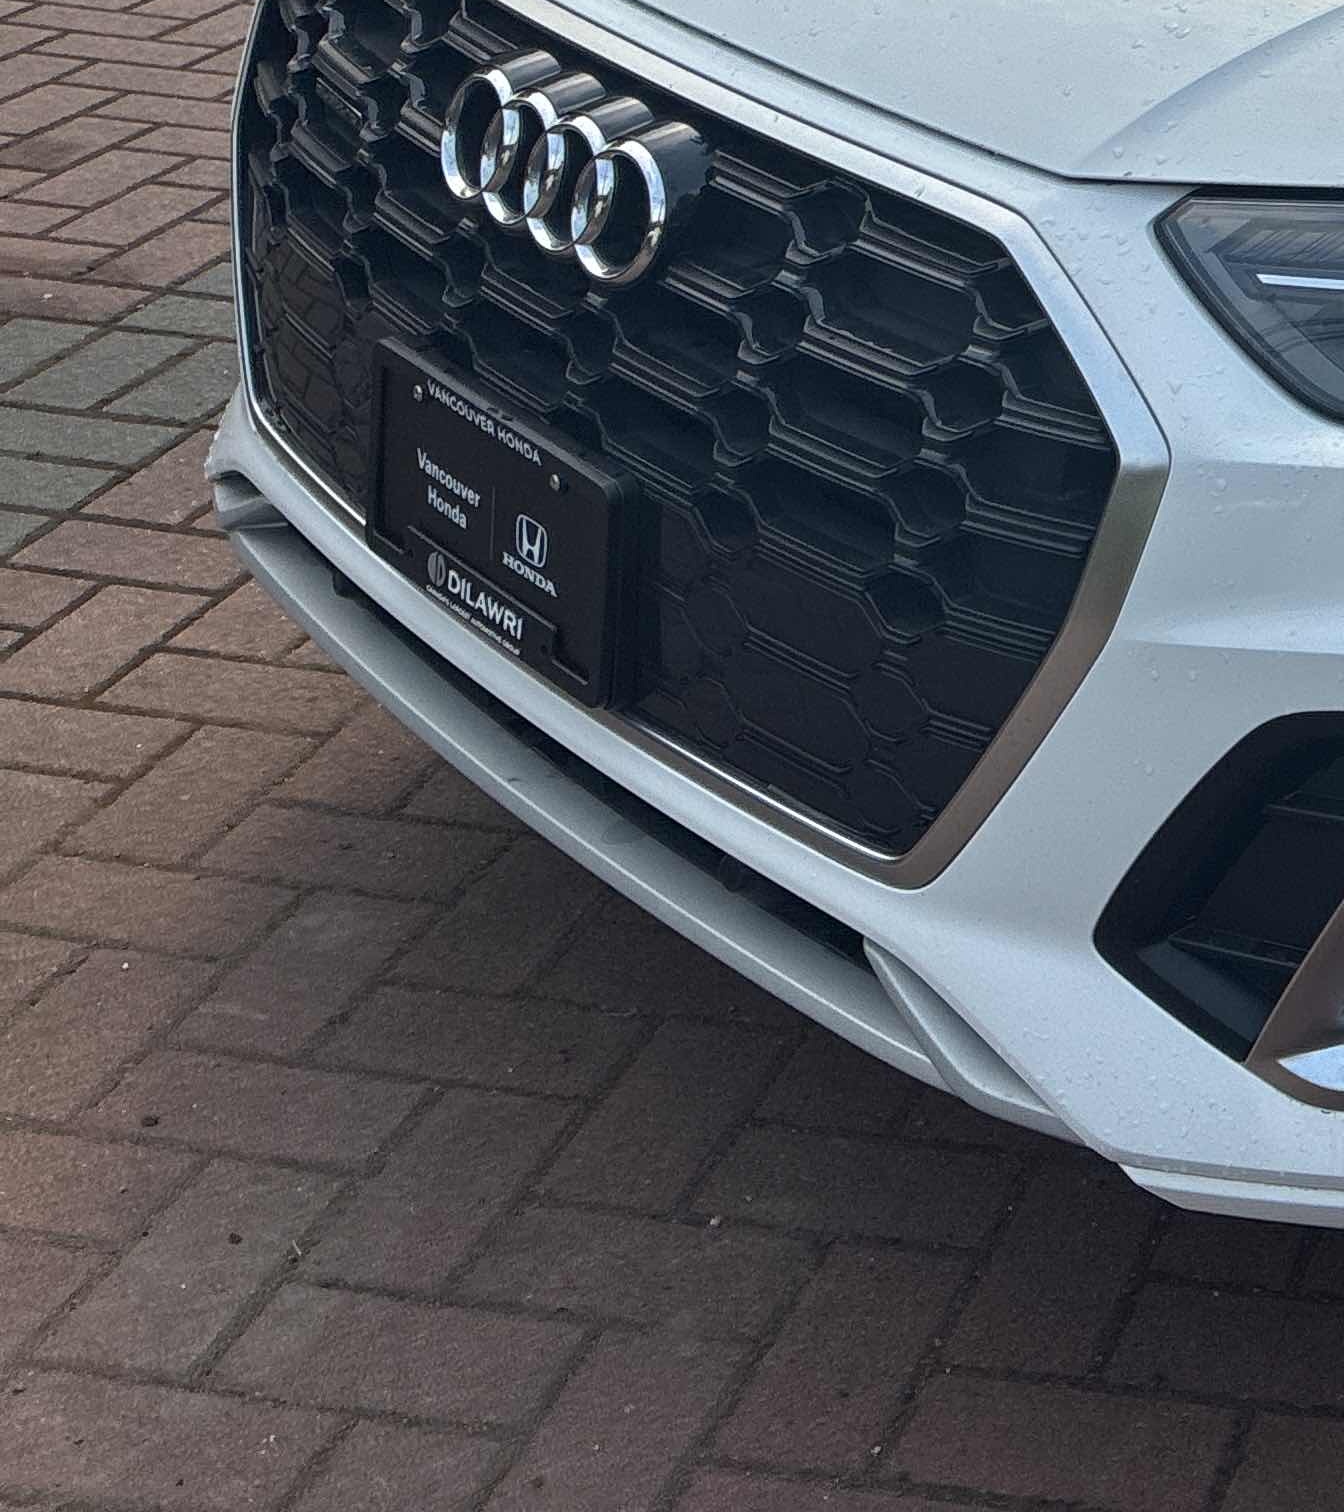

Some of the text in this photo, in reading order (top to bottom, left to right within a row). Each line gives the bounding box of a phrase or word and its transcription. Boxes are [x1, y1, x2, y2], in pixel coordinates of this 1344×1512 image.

[427, 379, 542, 466] VANCOUVER HONDA
[417, 447, 481, 507] Vancouver
[428, 485, 467, 529] Honda
[448, 569, 523, 640] DILAWRI
[502, 551, 558, 598] HONDA
